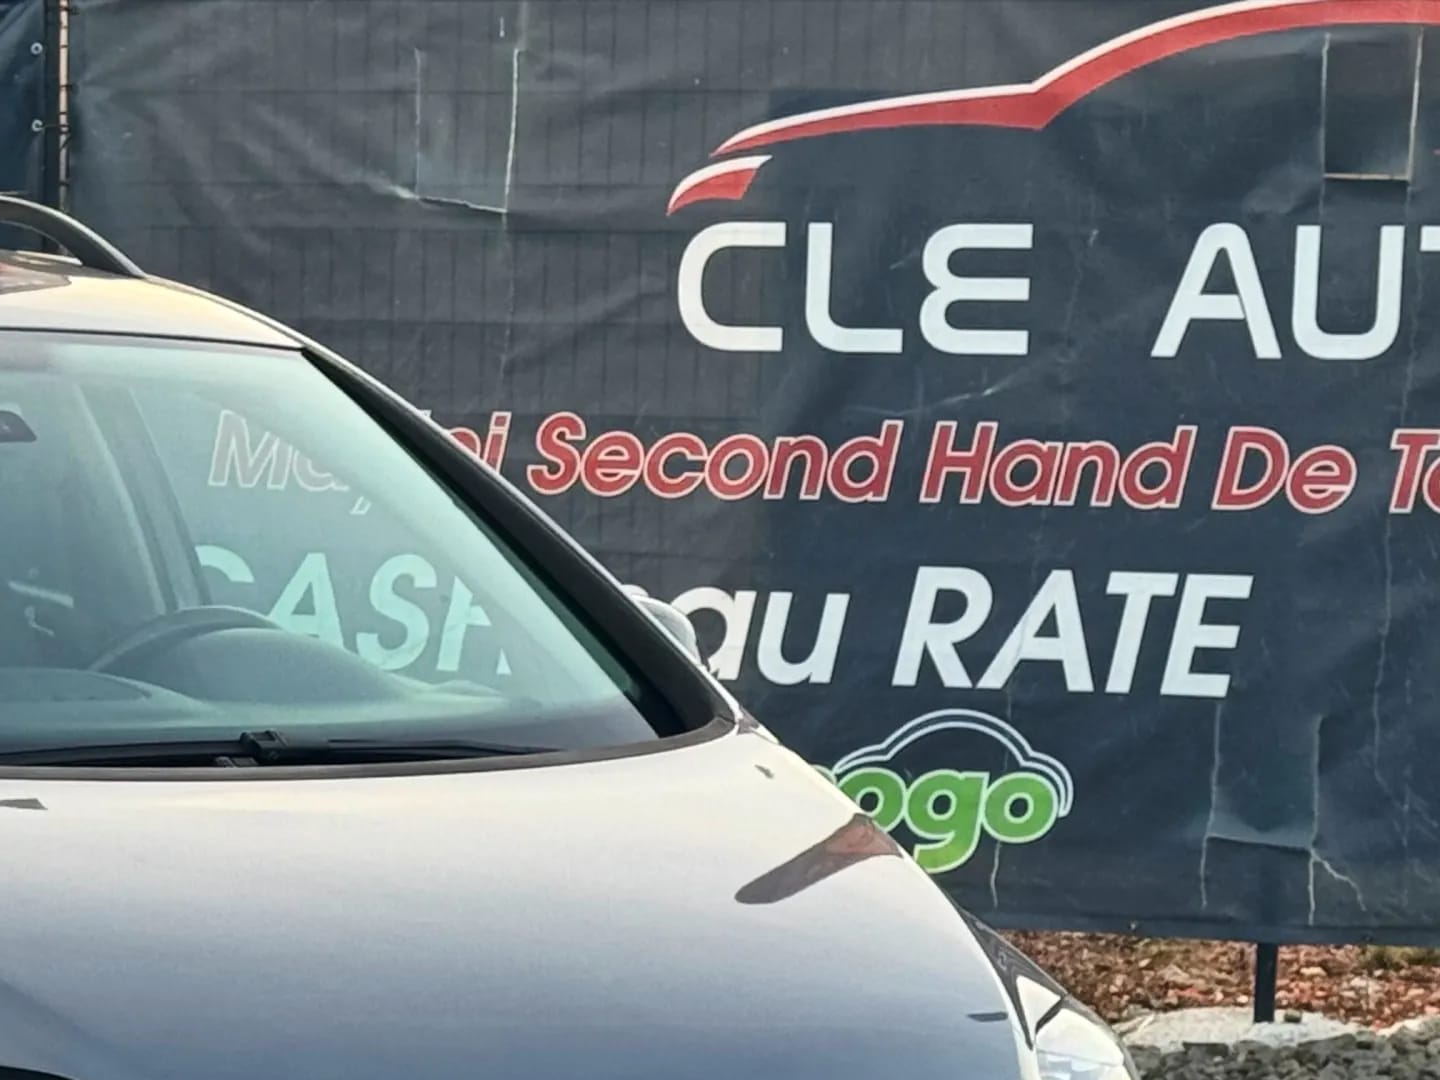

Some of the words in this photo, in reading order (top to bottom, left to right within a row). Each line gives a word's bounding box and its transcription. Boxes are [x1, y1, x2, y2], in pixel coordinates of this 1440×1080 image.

[677, 220, 1034, 356] CLE
[1150, 222, 1440, 360] AU
[526, 411, 905, 504] Second
[919, 421, 1198, 511] Hand
[1211, 426, 1358, 514] De
[621, 584, 851, 686] au
[892, 565, 1255, 698] RATE
[810, 764, 1058, 874] ogo
